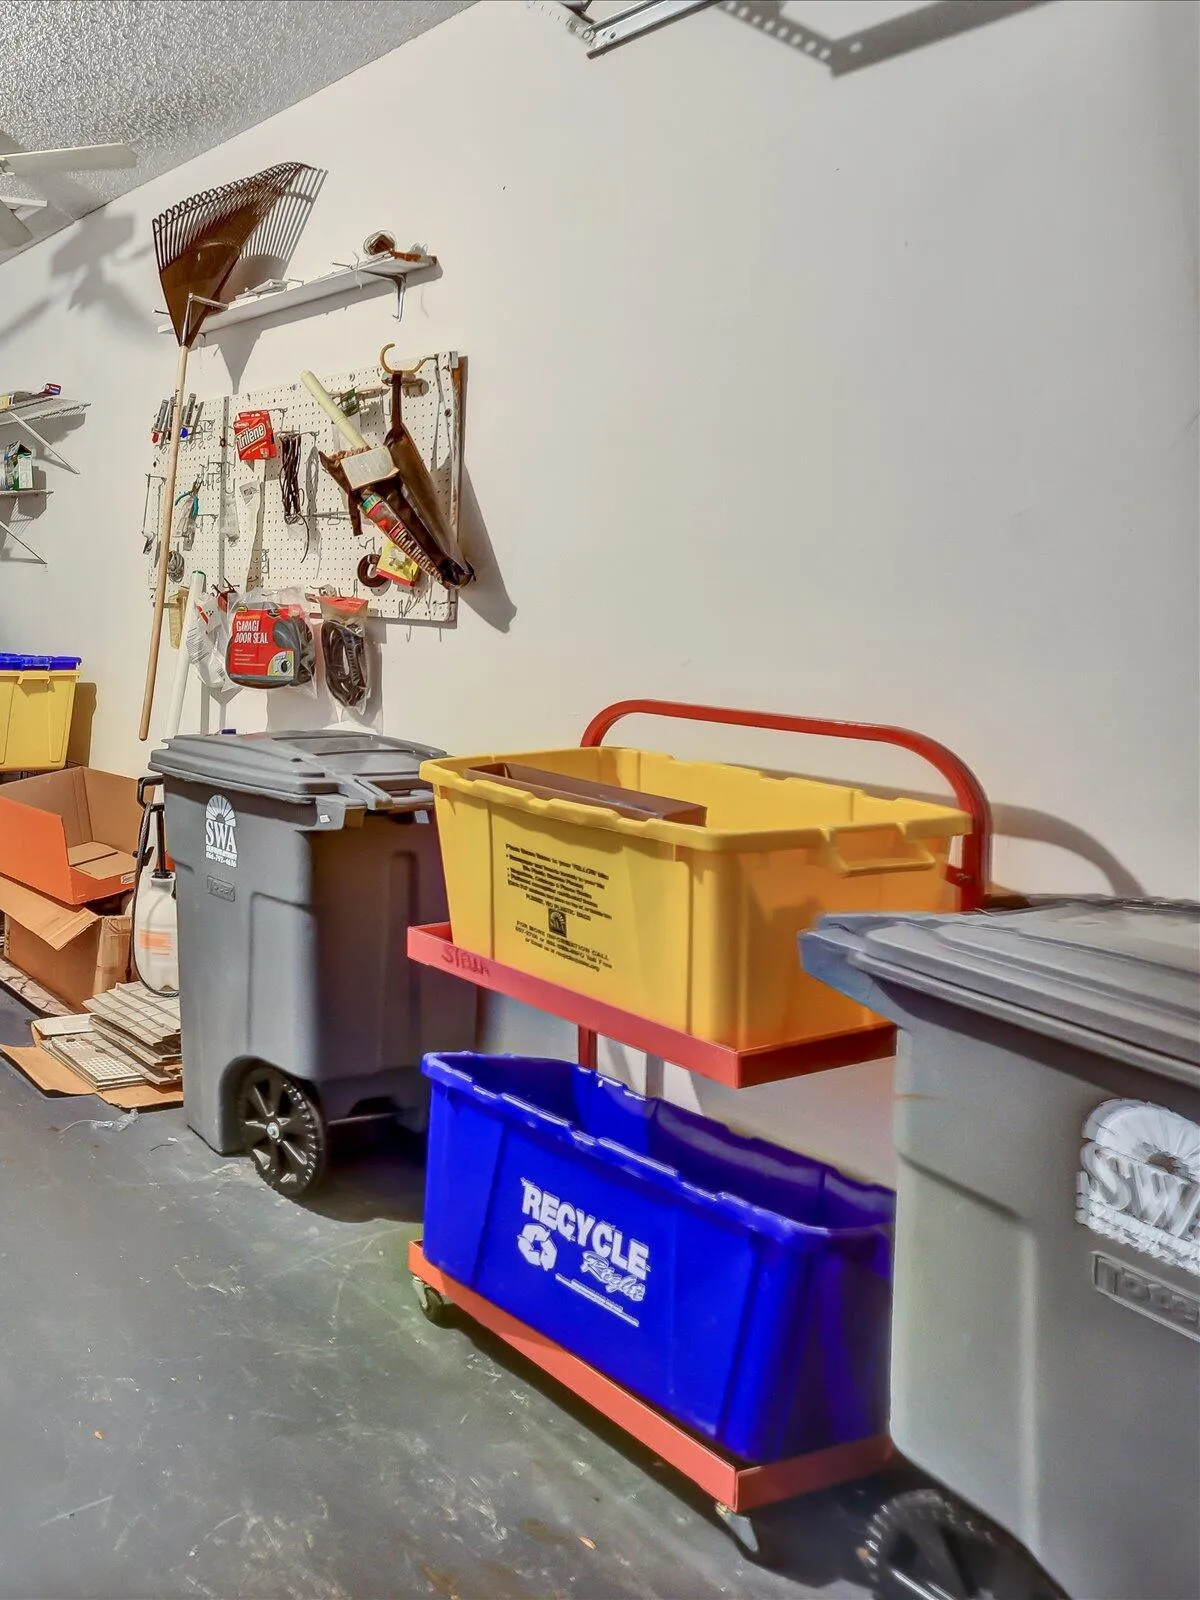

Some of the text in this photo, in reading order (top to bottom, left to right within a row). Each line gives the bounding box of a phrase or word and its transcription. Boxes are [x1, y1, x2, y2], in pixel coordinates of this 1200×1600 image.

[237, 424, 265, 448] Trilene
[234, 633, 269, 644] DOOR SEAL
[205, 819, 238, 854] SWA
[520, 1177, 650, 1280] RECYCLE
[580, 1250, 646, 1302] Right
